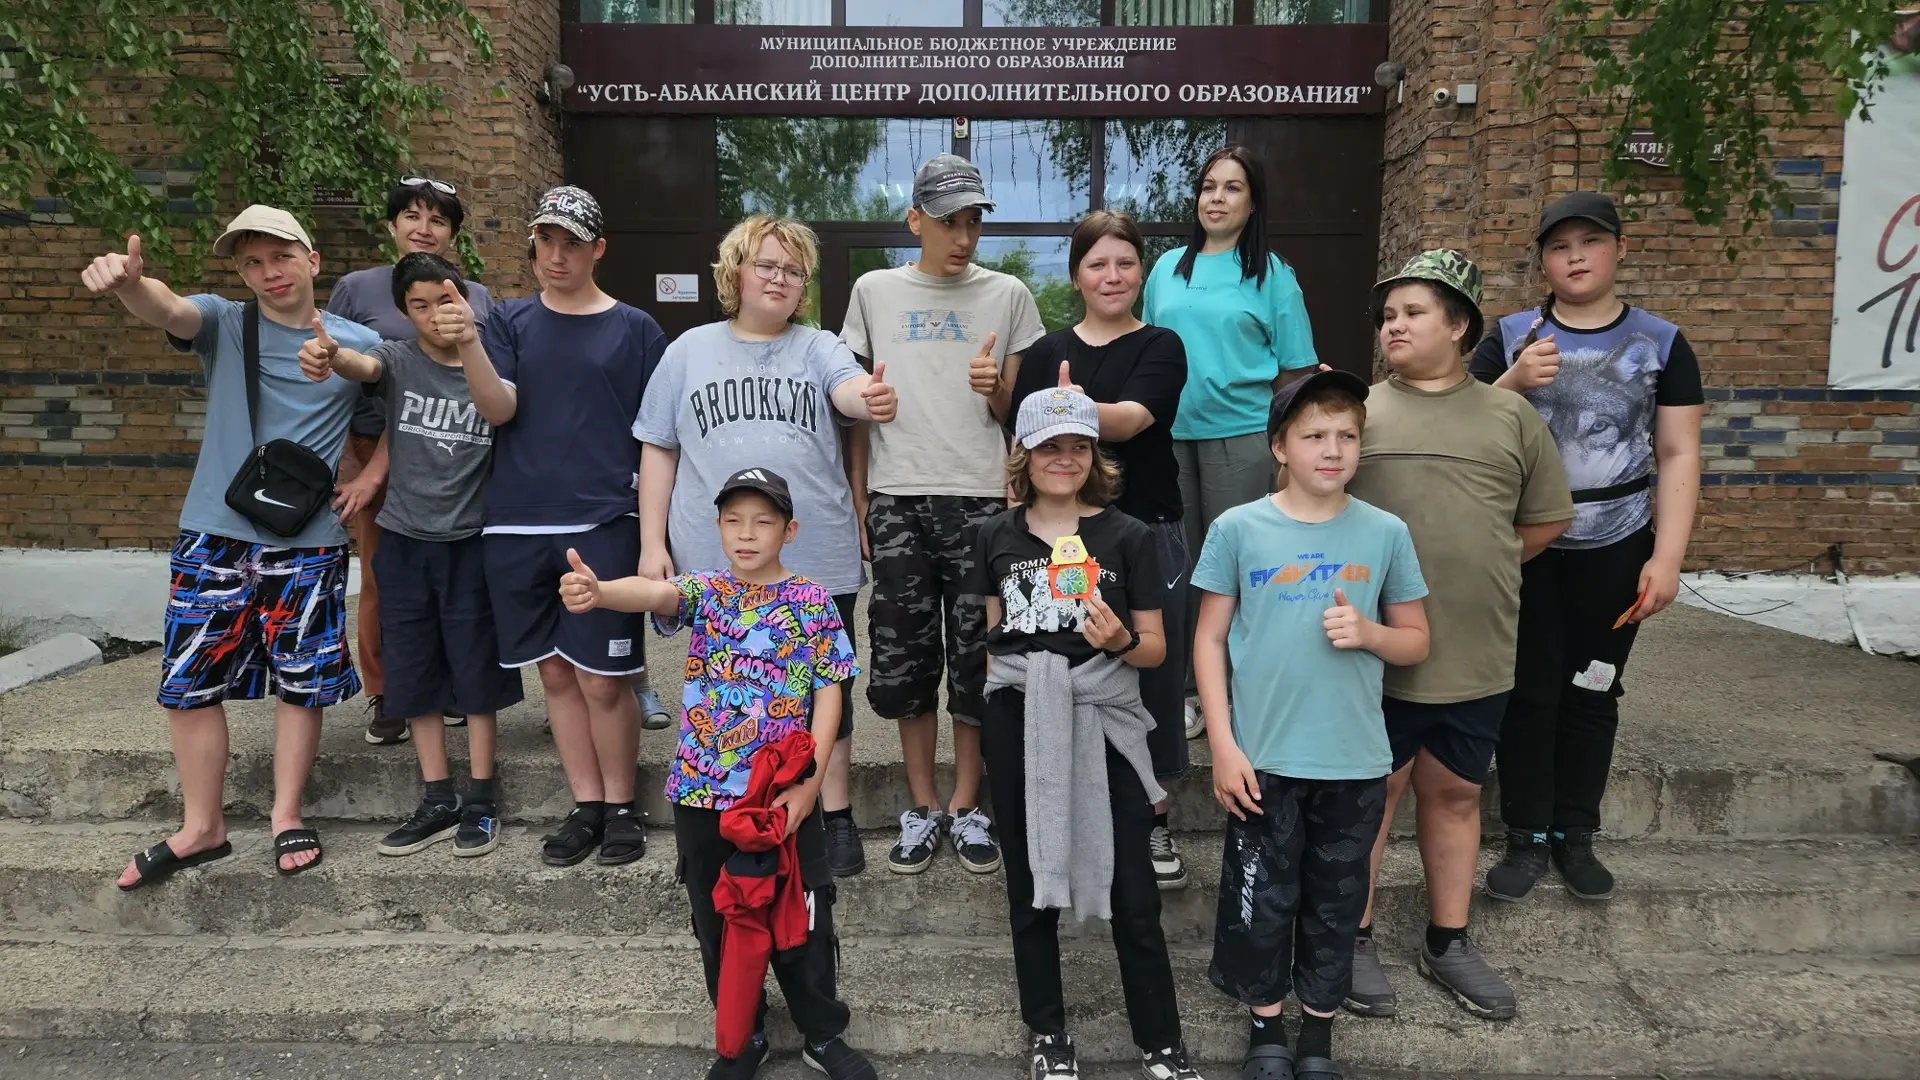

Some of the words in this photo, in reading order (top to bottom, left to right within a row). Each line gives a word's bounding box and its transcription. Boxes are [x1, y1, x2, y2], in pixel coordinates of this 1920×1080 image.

[759, 37, 924, 53] МУНИЦИПАЛЬНОЕ
[929, 37, 1047, 53] БЮДЖЕТНОЕ
[1051, 37, 1177, 53] УЧРЕЖДЕНИЕ
[809, 54, 991, 71] ДОПОЛНИТЕЛЬНОГО
[996, 54, 1126, 71] ОБРАЗОВАНИЯ
[830, 83, 911, 105] ЦЕНТР
[918, 83, 1170, 105] ДОПОЛНИТЕЛЬНОГО
[545, 194, 585, 216] FILA
[735, 364, 778, 374] 1898
[689, 376, 818, 439] BROOKLYN
[401, 424, 437, 438] ORIGINAL
[706, 436, 744, 450] NEW
[763, 434, 813, 446] YORK
[1310, 552, 1325, 560] ARE
[1308, 587, 1330, 602] Give
